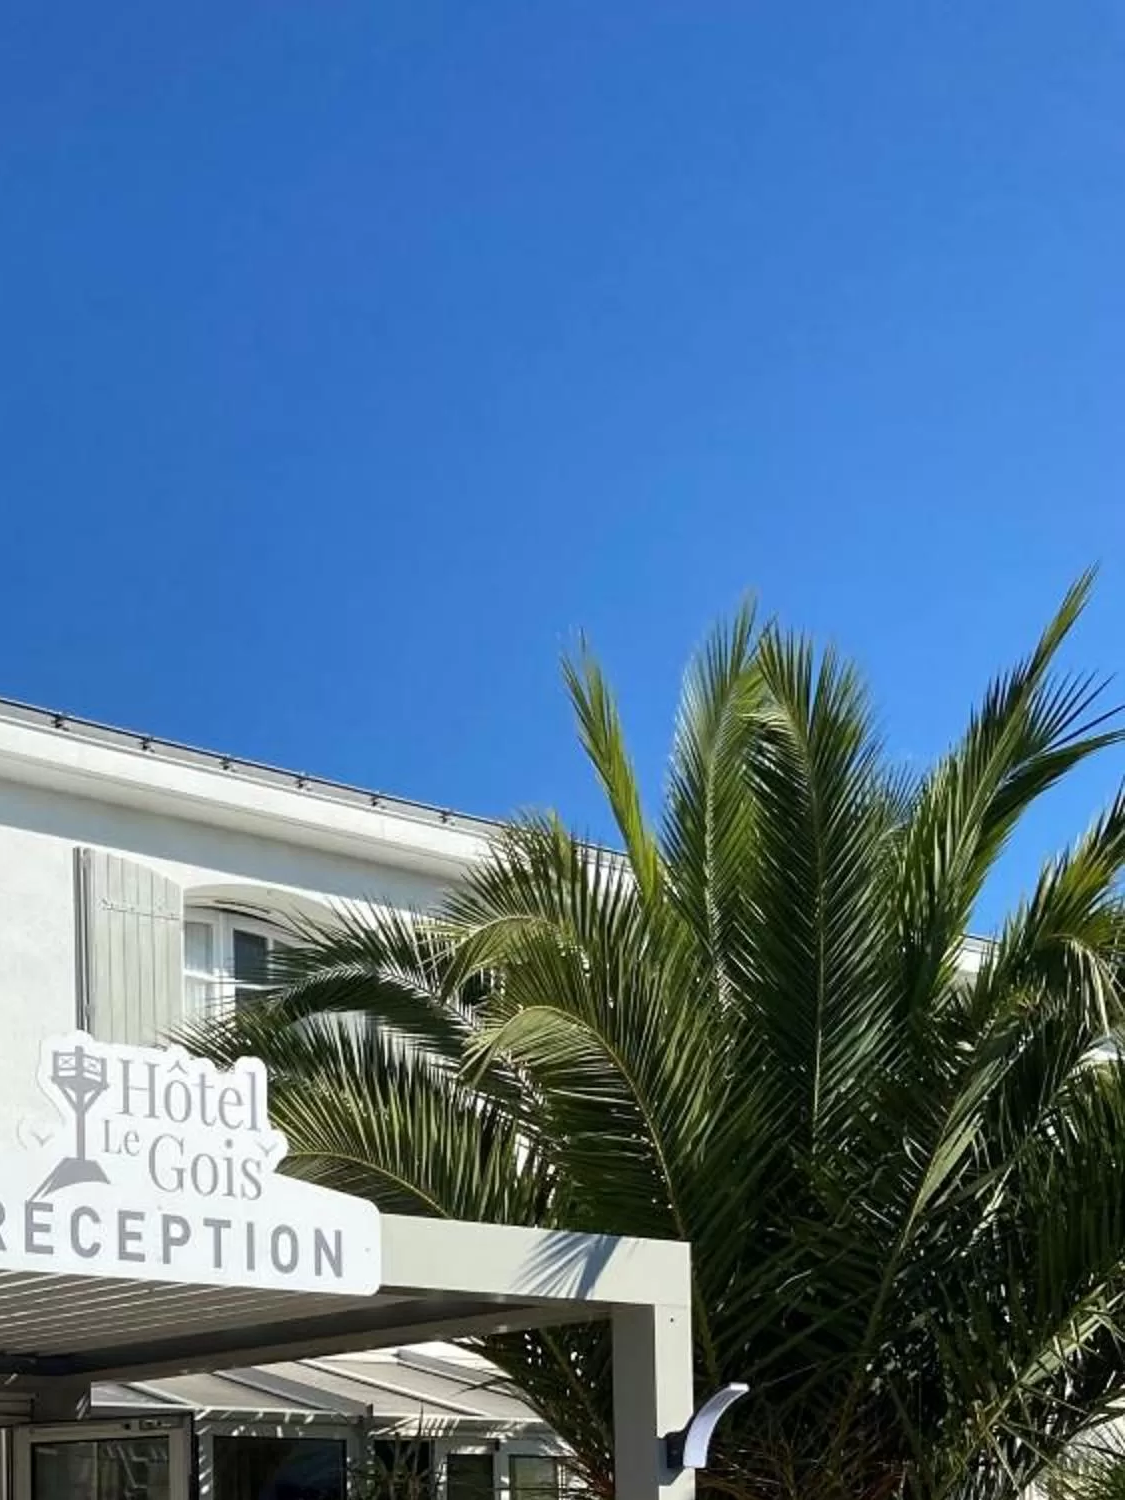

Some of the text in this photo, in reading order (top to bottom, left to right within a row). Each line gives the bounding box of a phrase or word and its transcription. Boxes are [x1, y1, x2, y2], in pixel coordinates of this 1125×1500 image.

[116, 1058, 262, 1131] Hôtel
[104, 1120, 263, 1200] Le Gois
